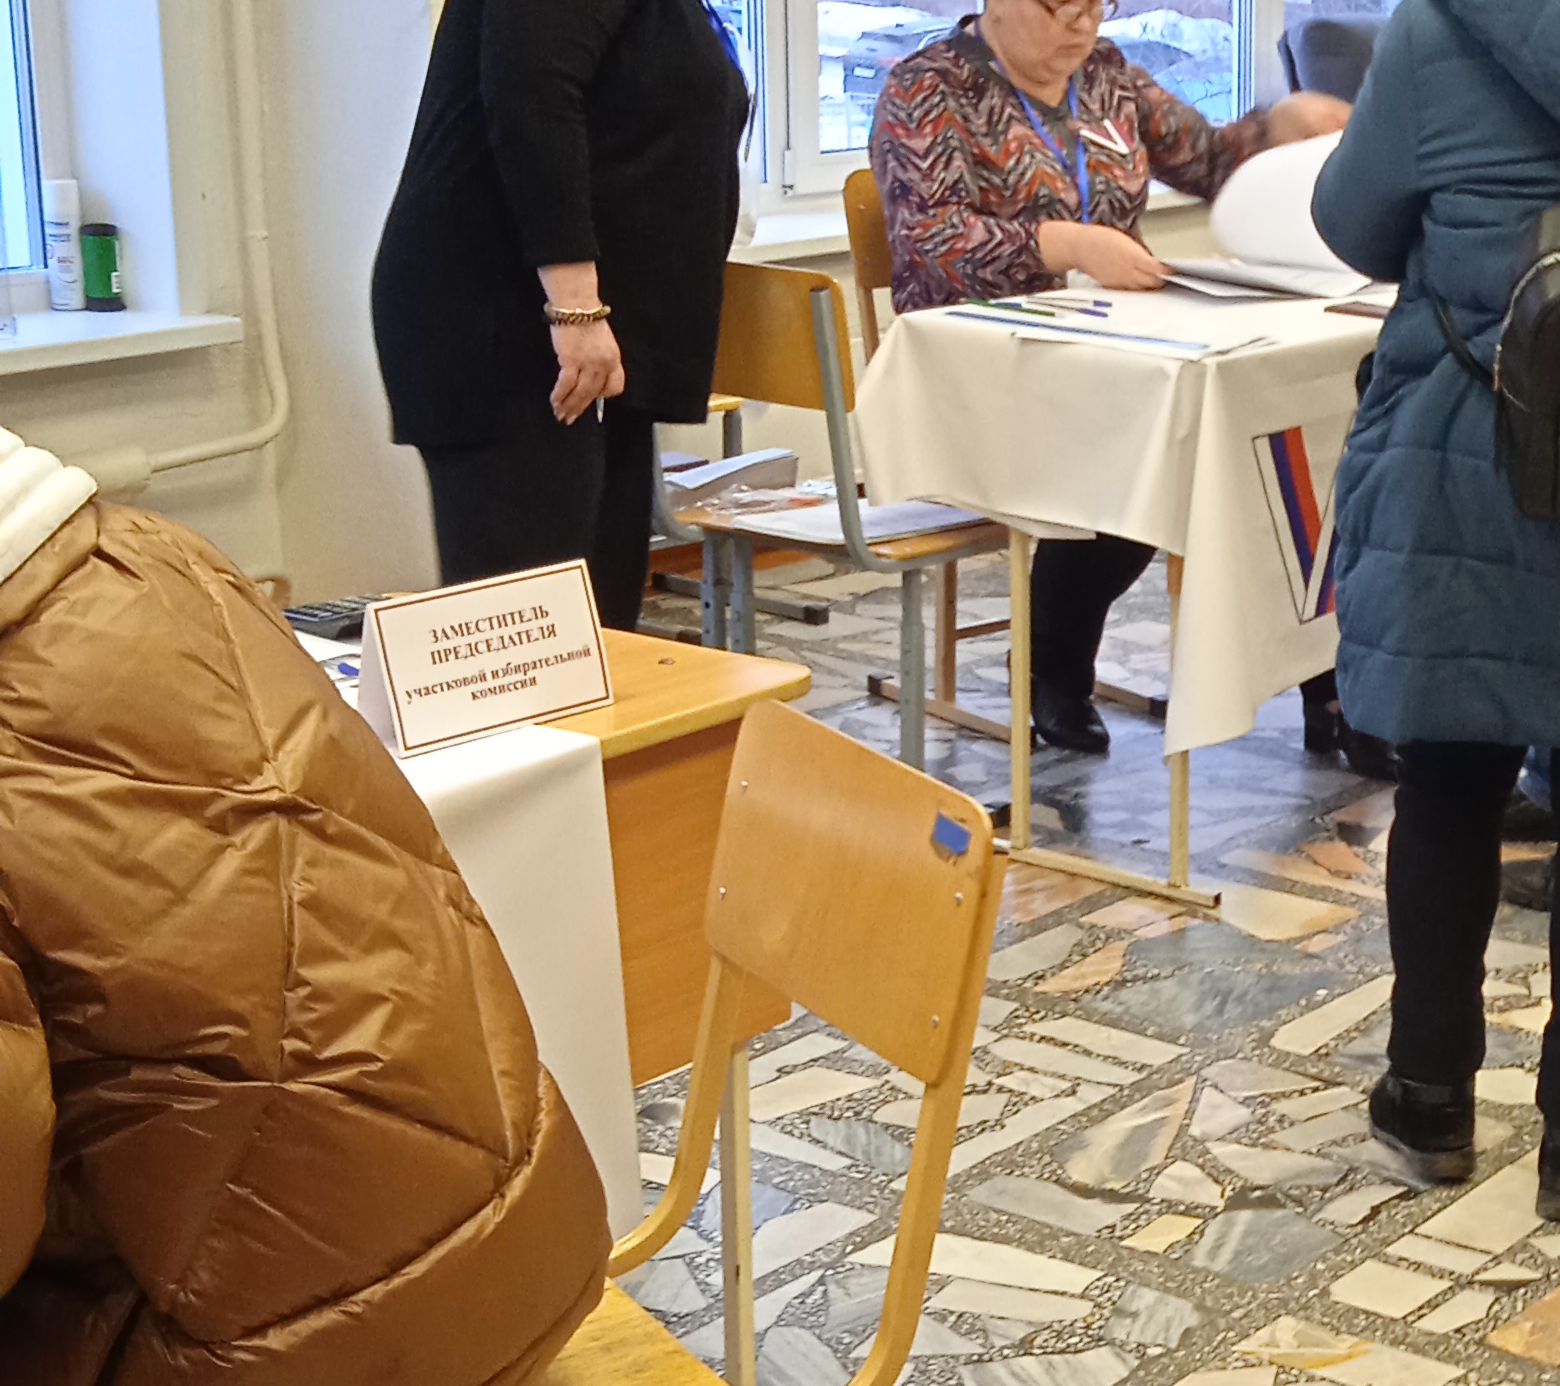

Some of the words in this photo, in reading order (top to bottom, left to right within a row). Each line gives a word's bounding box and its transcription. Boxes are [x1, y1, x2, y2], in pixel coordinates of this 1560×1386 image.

[429, 605, 550, 644] ЗАМЕСТИТЕЛЬ
[430, 623, 557, 666] ПРЕДСЕДАТЕЛЯ
[405, 668, 488, 704] участковой
[491, 644, 592, 682] избирательной
[471, 676, 538, 701] комиссии
